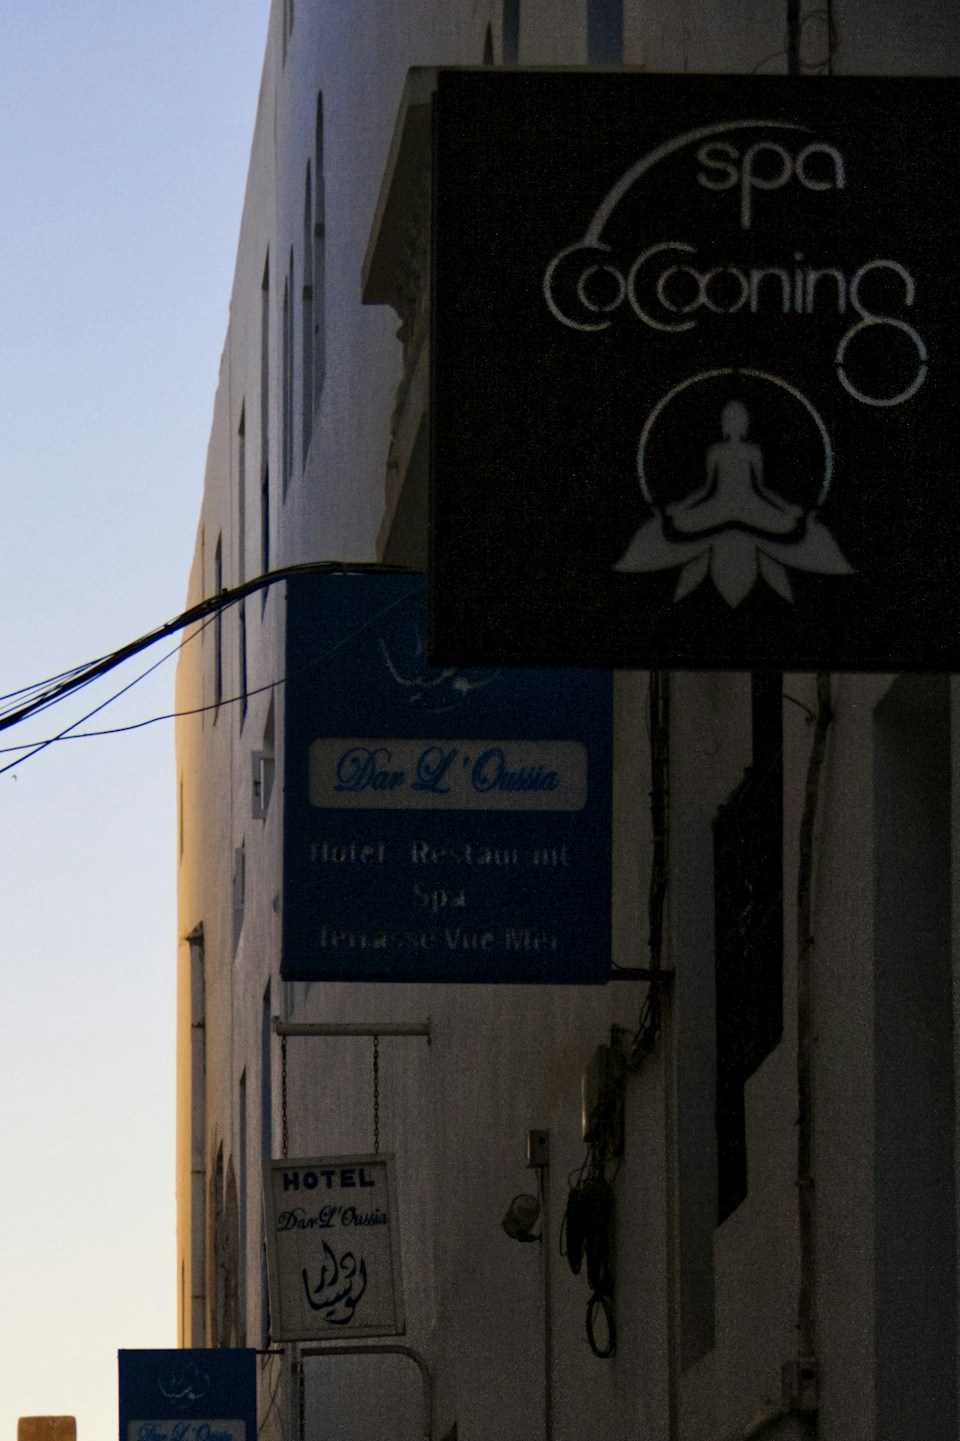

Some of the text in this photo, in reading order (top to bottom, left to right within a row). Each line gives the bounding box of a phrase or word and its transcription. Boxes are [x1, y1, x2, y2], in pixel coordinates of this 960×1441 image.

[694, 139, 847, 229] spa
[333, 747, 404, 792] Dar
[309, 839, 571, 867] Hotel Restaurant
[413, 882, 467, 914] Spa
[319, 925, 559, 952] Terrasse Vue Mer
[282, 1168, 376, 1191] HOTEL
[276, 1207, 318, 1232] Dar
